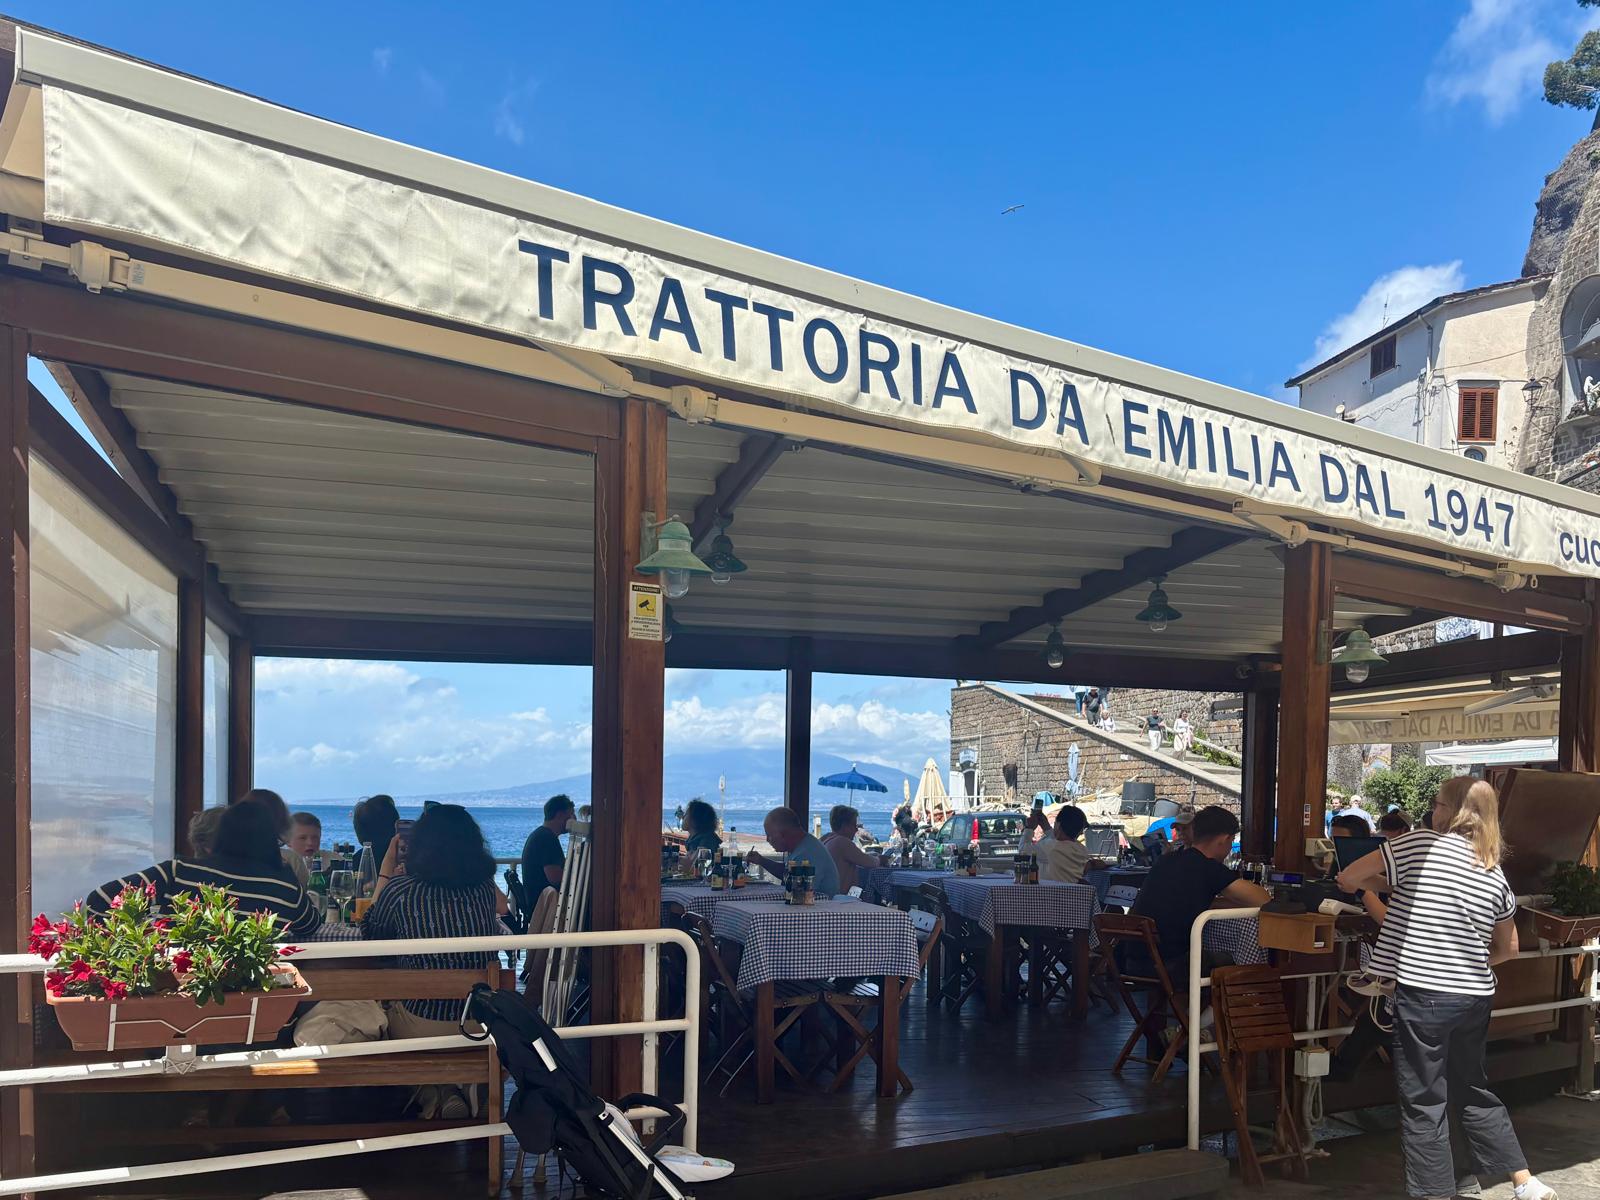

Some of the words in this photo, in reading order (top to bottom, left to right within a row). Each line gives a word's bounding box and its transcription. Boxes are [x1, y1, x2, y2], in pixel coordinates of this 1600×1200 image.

[518, 239, 978, 415] TRATTORIA
[1009, 369, 1089, 446] DA
[1122, 399, 1300, 492] EMILIA
[1319, 454, 1405, 520] DAL
[1424, 483, 1515, 548] 1947
